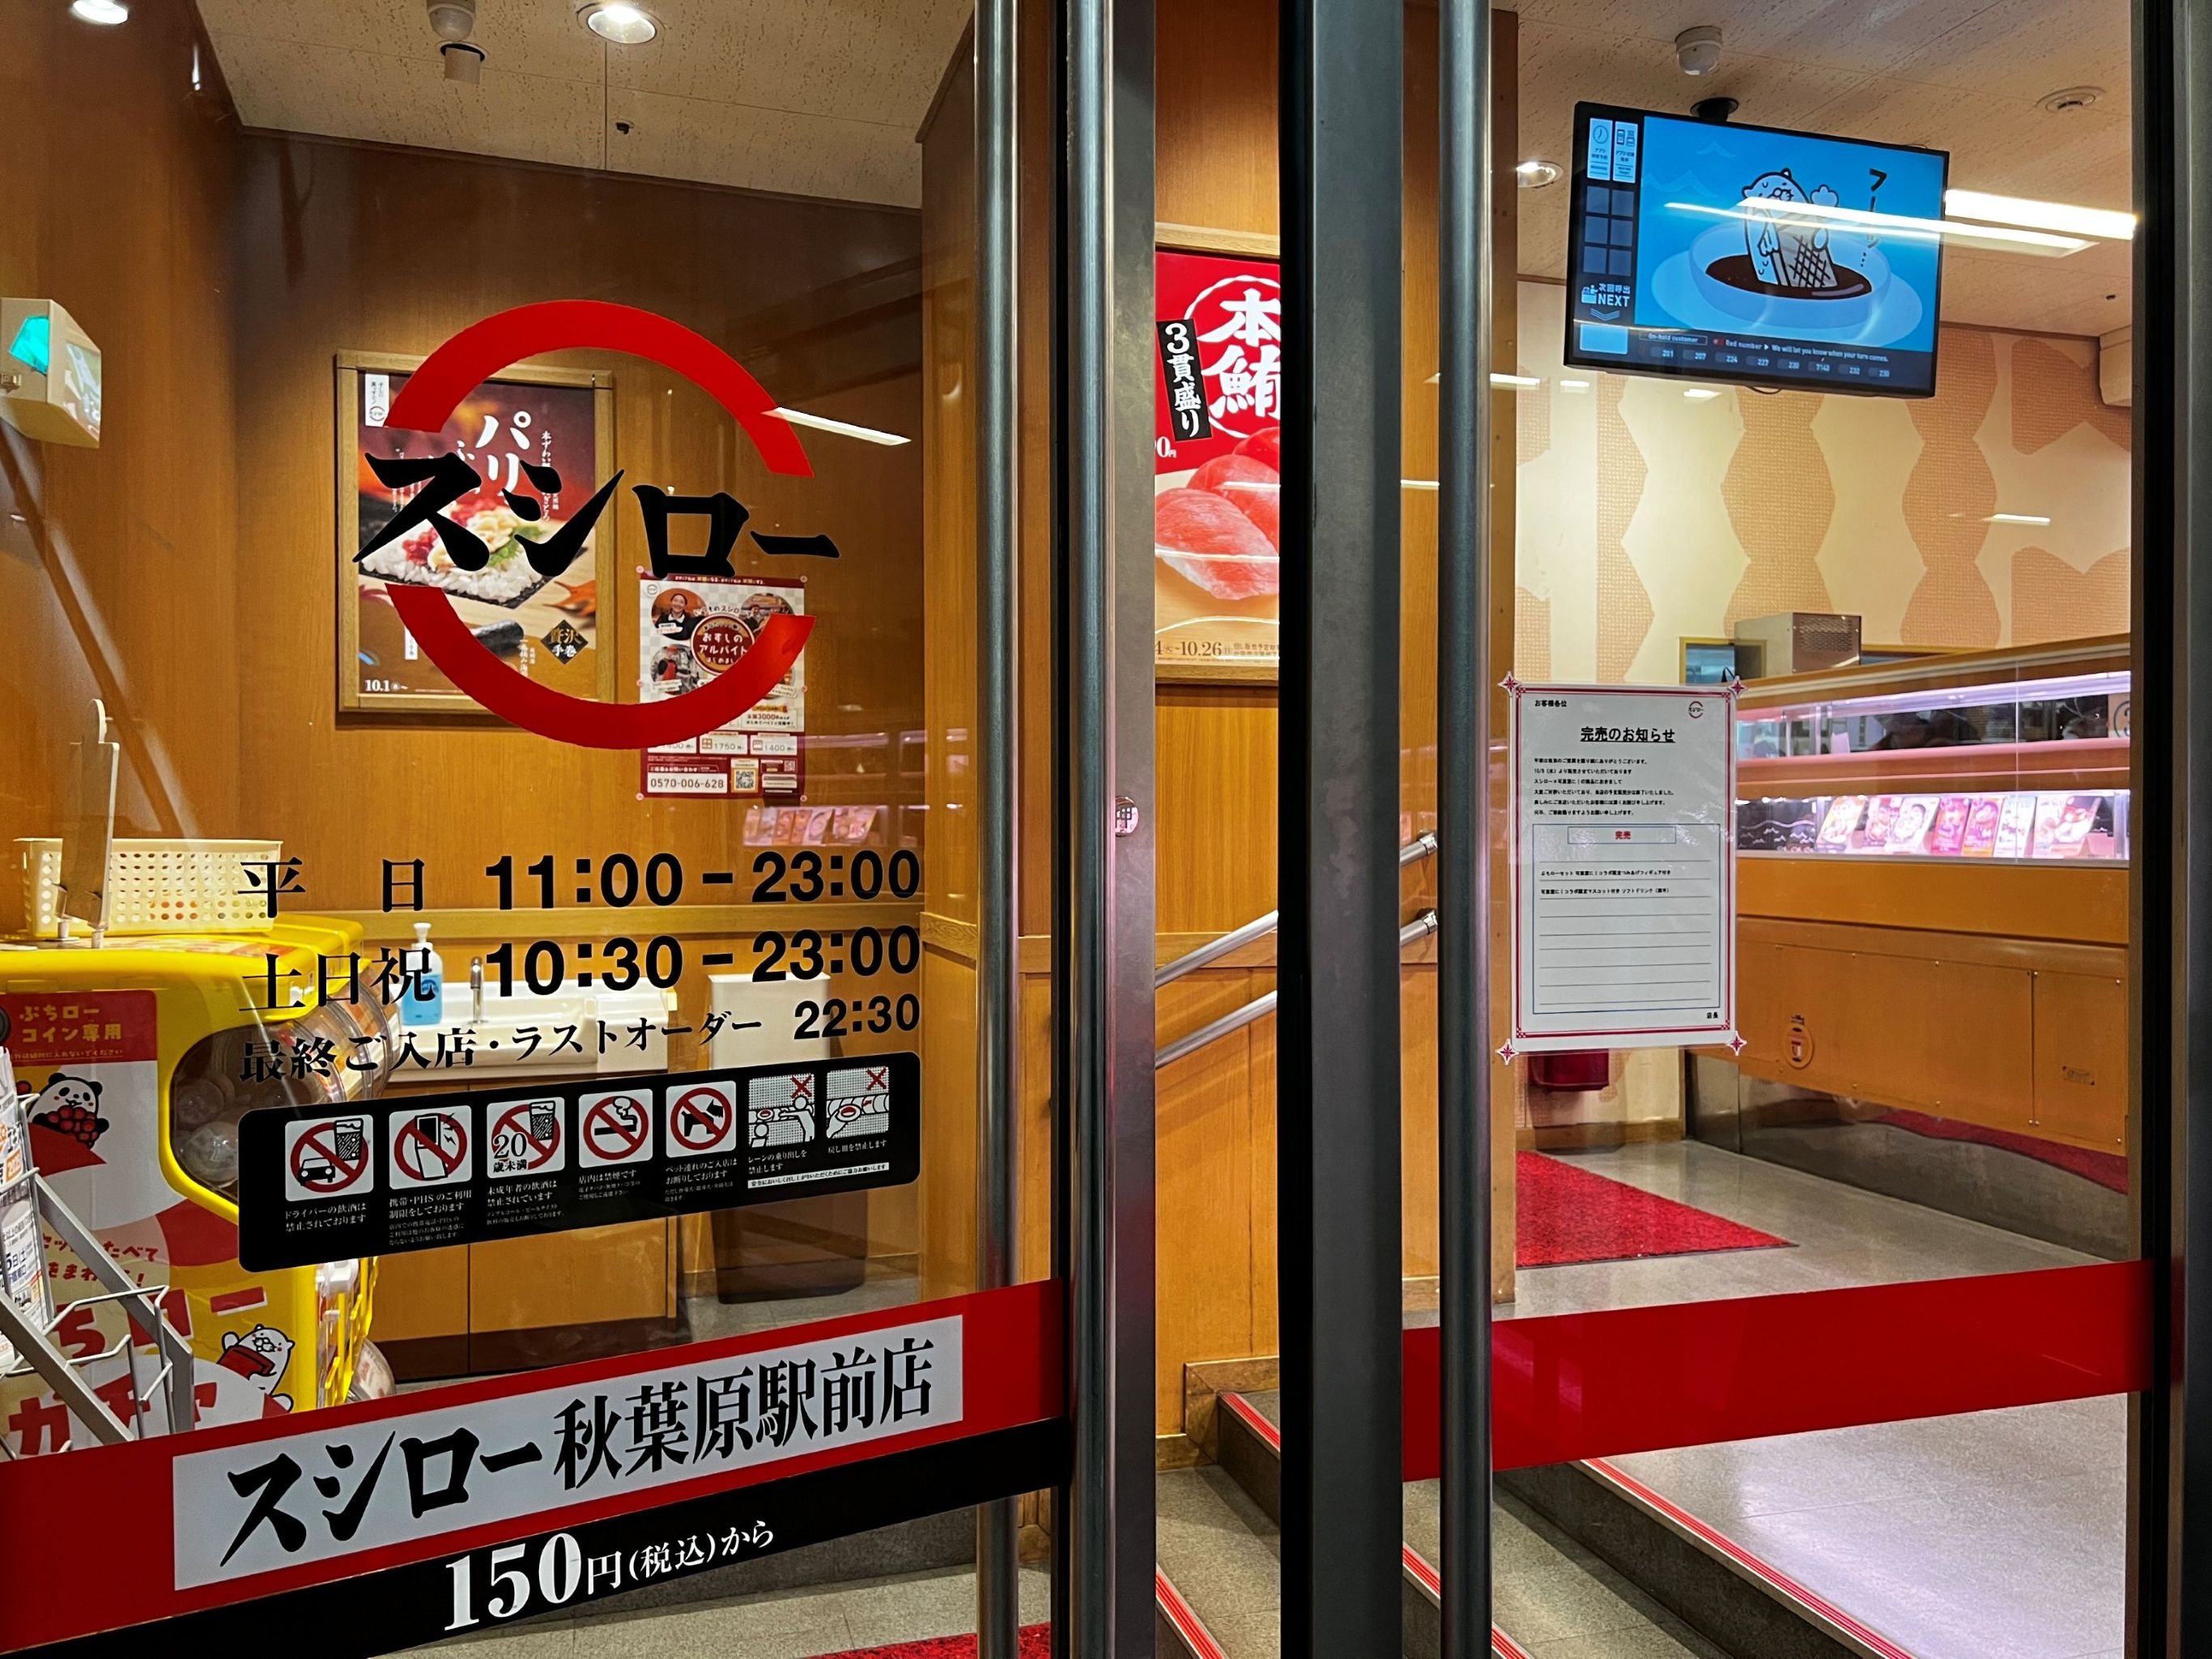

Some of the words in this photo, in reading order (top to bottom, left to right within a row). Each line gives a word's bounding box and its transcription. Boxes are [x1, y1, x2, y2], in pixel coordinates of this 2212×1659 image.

[1597, 293, 1630, 307] NEXT
[1164, 322, 1202, 438] 3貫盛り
[353, 452, 840, 578] スシロー
[703, 632, 743, 644] おすしの
[551, 644, 577, 657] 手巻
[699, 644, 749, 657] アルバイト
[1580, 726, 1675, 742] 完売のお知らせ
[650, 778, 724, 789] 0570-006-628
[1615, 831, 1631, 840] 完売
[486, 853, 683, 910] 11:00
[751, 849, 921, 903] 23:00
[239, 946, 436, 1012] 土日祝
[486, 935, 683, 998] 10:30
[751, 925, 921, 983] 23:00
[23, 1023, 122, 1044] コイン専用
[240, 1010, 762, 1083] 最終ご入店・ラストオーダー
[793, 993, 921, 1040] 22:30
[493, 1132, 527, 1159] 20
[666, 1157, 738, 1172] ペット連れのご入店は
[748, 1150, 808, 1163] レーンの乗り出しを
[493, 1159, 528, 1173] 歳未満
[748, 1163, 784, 1175] 禁止します
[579, 1169, 637, 1185] 店内は禁煙です
[666, 1169, 728, 1185] お断りしております
[487, 1180, 558, 1196] 未成年者の飲酒は
[487, 1191, 553, 1207] 禁止されています
[286, 1202, 367, 1220] ドライバーの飲酒は
[389, 1202, 465, 1219] 制限をしております
[286, 1214, 367, 1232] 禁止されております
[445, 1520, 774, 1631] 150円(税込)から
